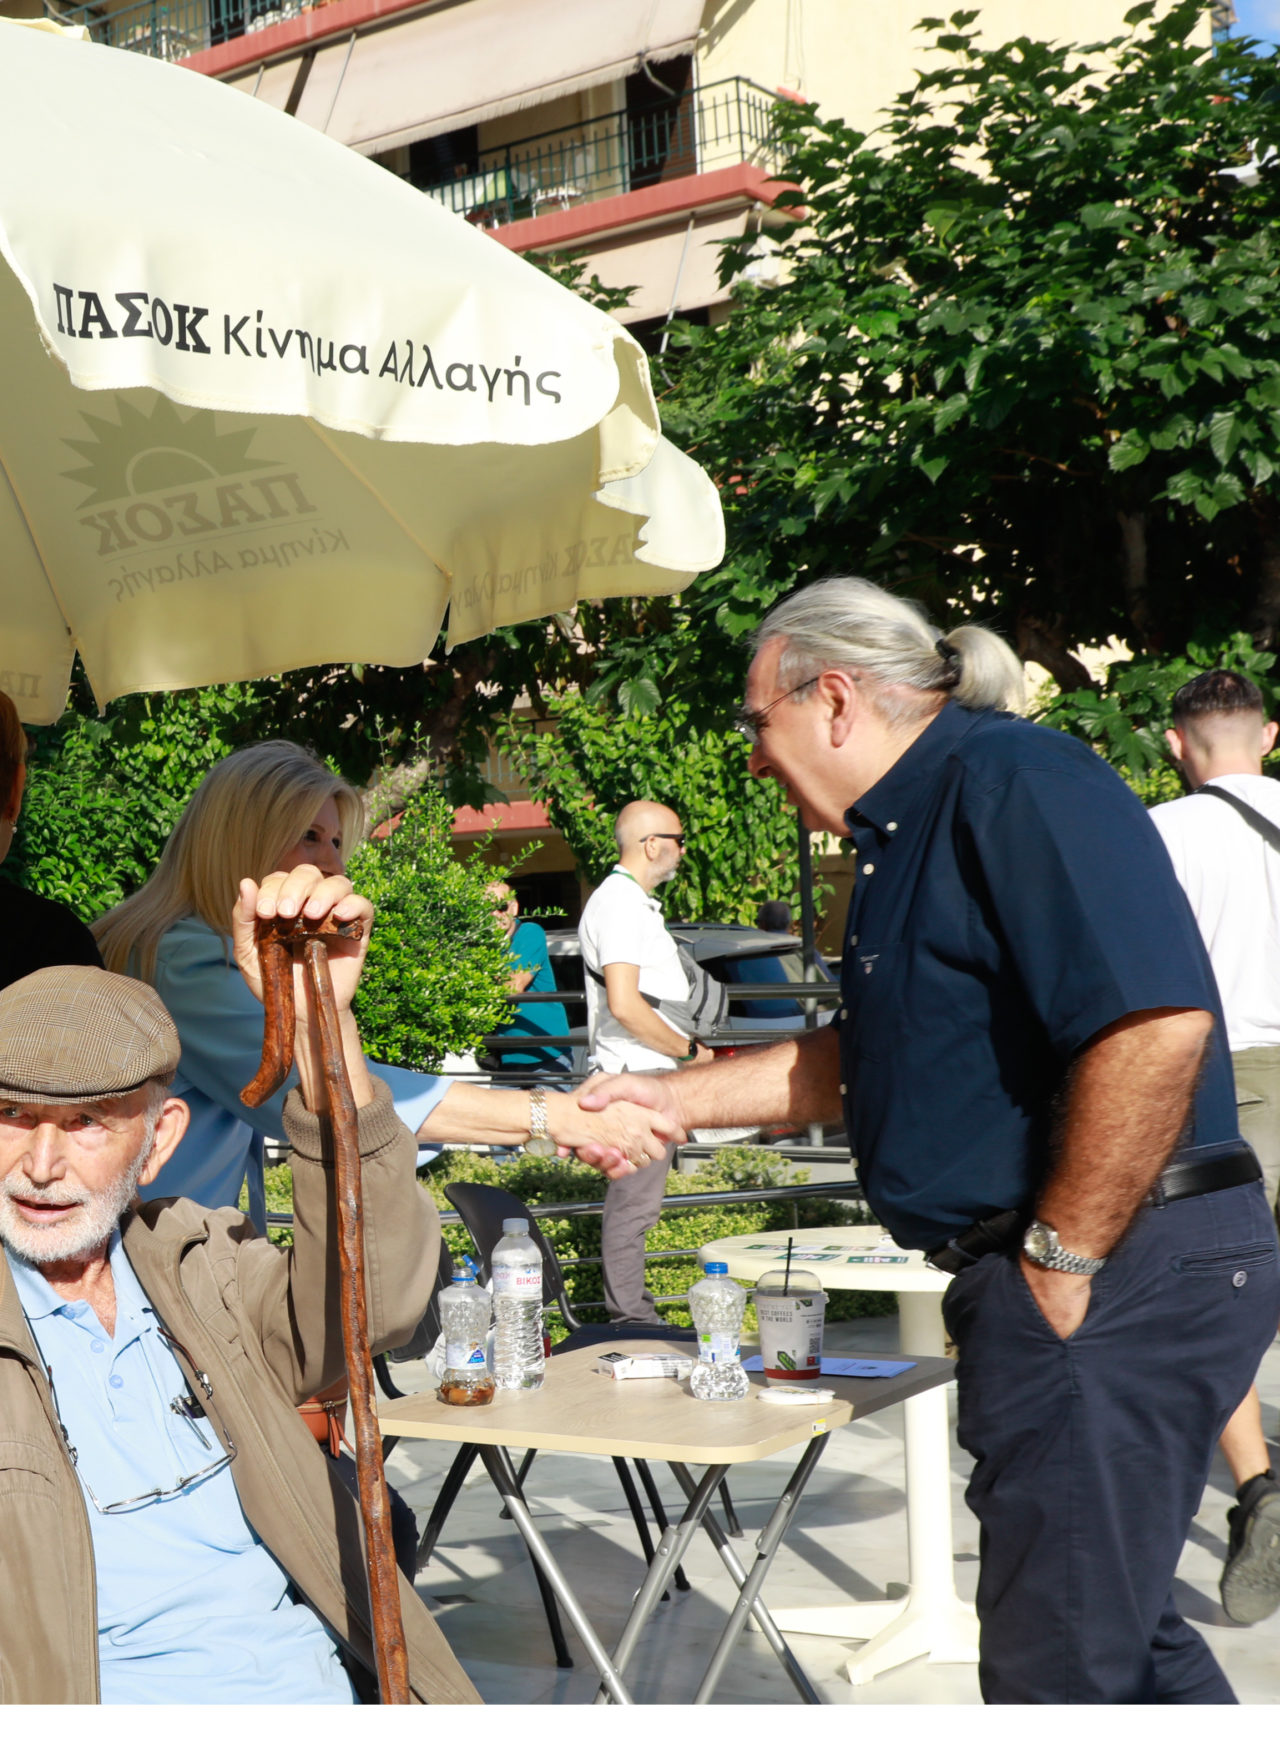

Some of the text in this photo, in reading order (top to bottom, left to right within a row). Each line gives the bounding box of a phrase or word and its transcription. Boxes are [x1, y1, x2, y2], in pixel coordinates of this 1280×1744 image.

[52, 282, 562, 406] ΠΑΣΟΚ Κίνημα Αλλαγής
